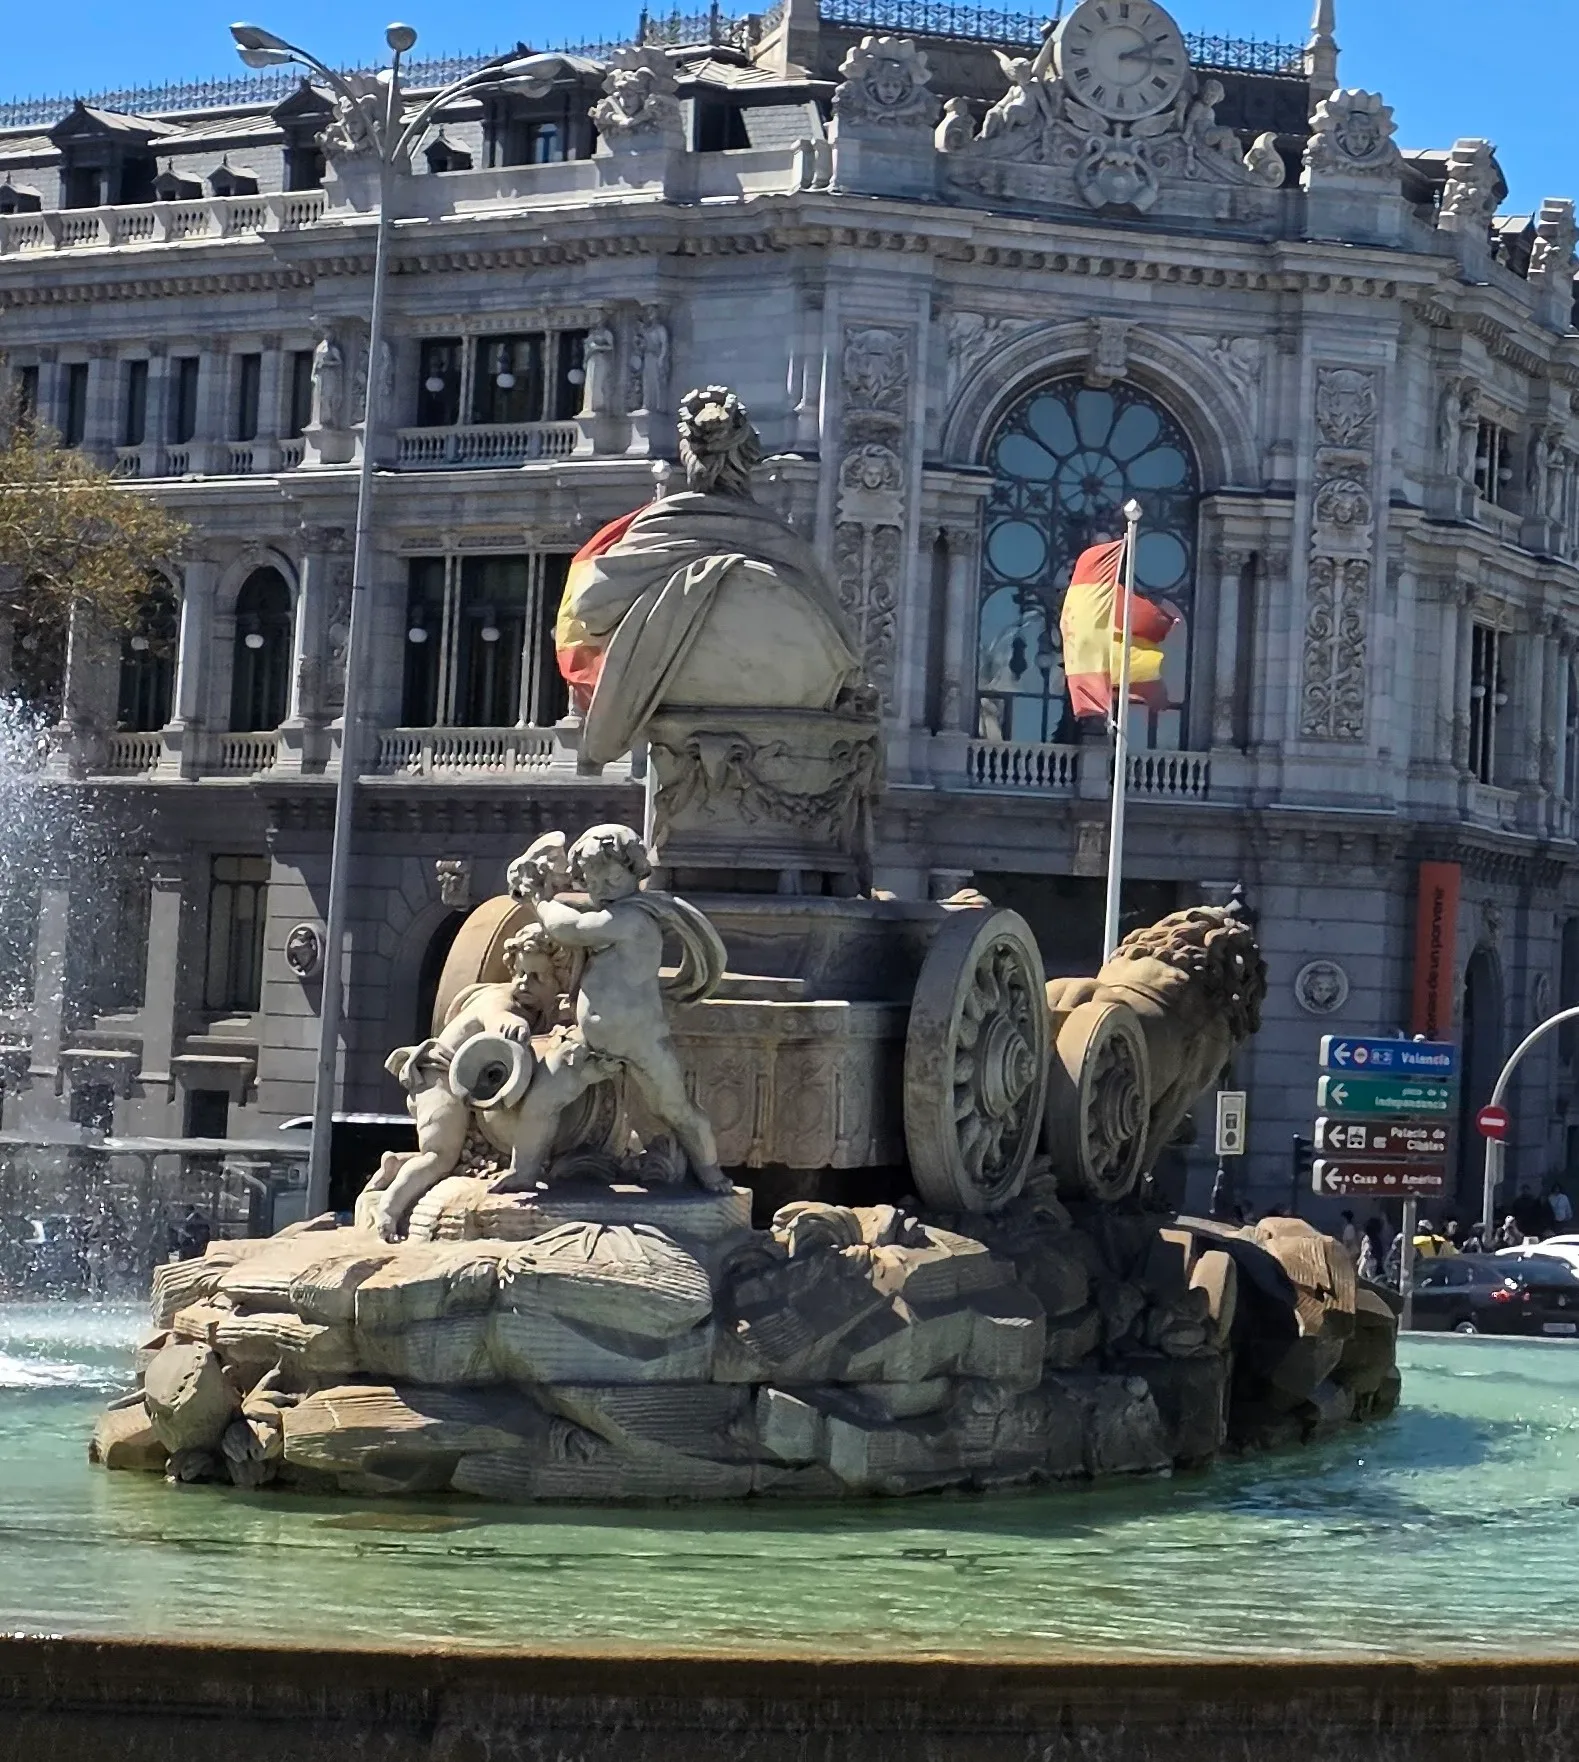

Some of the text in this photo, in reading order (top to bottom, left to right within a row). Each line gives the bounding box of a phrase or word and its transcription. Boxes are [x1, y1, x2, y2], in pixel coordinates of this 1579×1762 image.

[1401, 1051, 1450, 1066] Valencia
[1353, 1174, 1377, 1184] Casa
[1383, 1174, 1397, 1185] de
